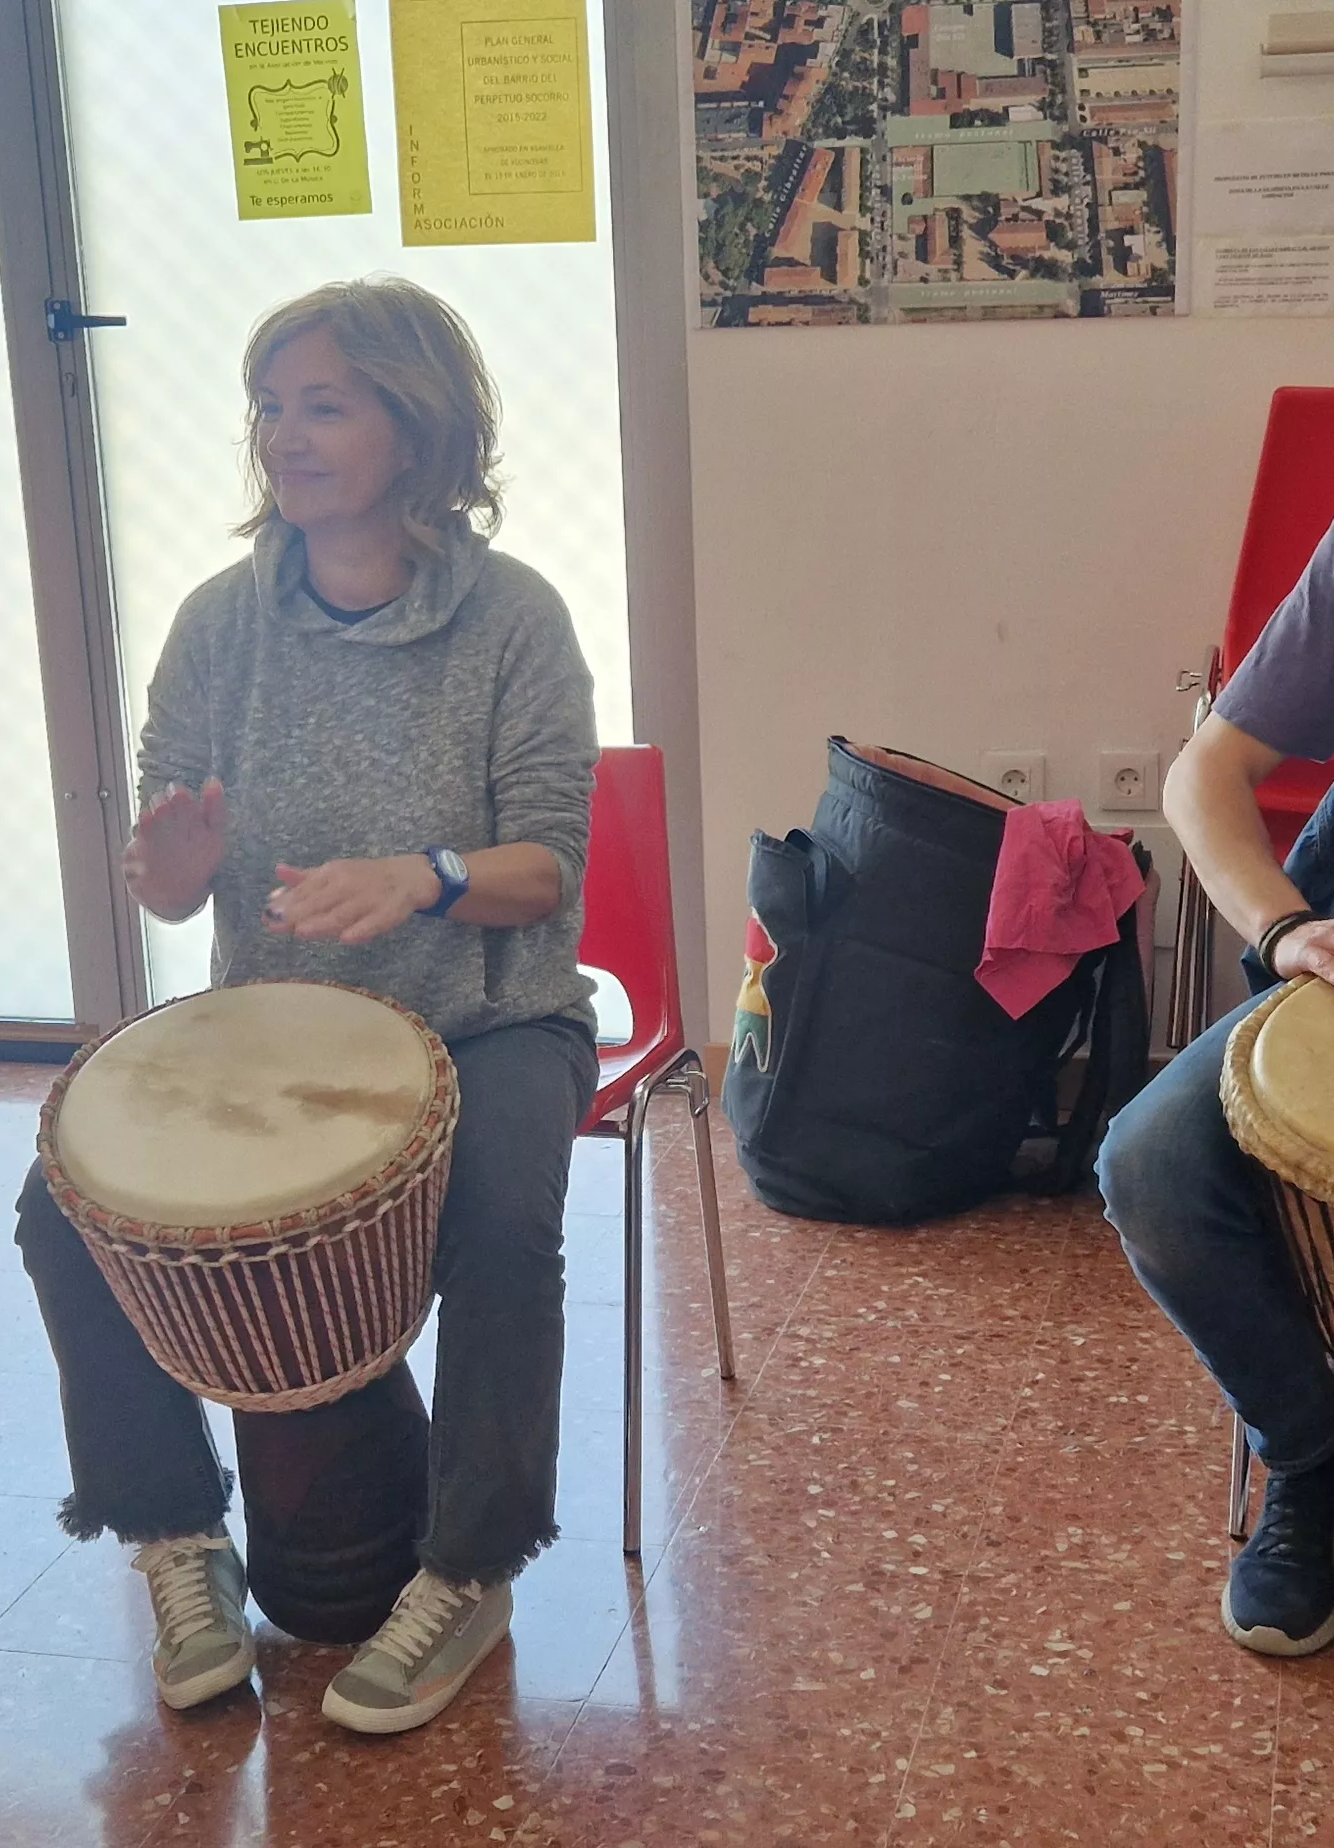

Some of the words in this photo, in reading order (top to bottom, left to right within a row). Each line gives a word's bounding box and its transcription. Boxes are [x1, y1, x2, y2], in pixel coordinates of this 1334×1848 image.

[249, 15, 329, 37] TEJIENDO
[234, 36, 349, 59] ENCUENTROS
[484, 36, 509, 47] PLAN
[511, 34, 555, 46] GENERAL
[540, 54, 573, 64] SOCIAL
[483, 74, 499, 85] DEL
[503, 73, 539, 85] BARRIO
[474, 93, 523, 104] PERPETUO
[525, 92, 570, 103] SOCORRO
[249, 195, 262, 207] Te
[266, 193, 334, 208] esperamos
[413, 212, 505, 231] ASOCIACIÓN
